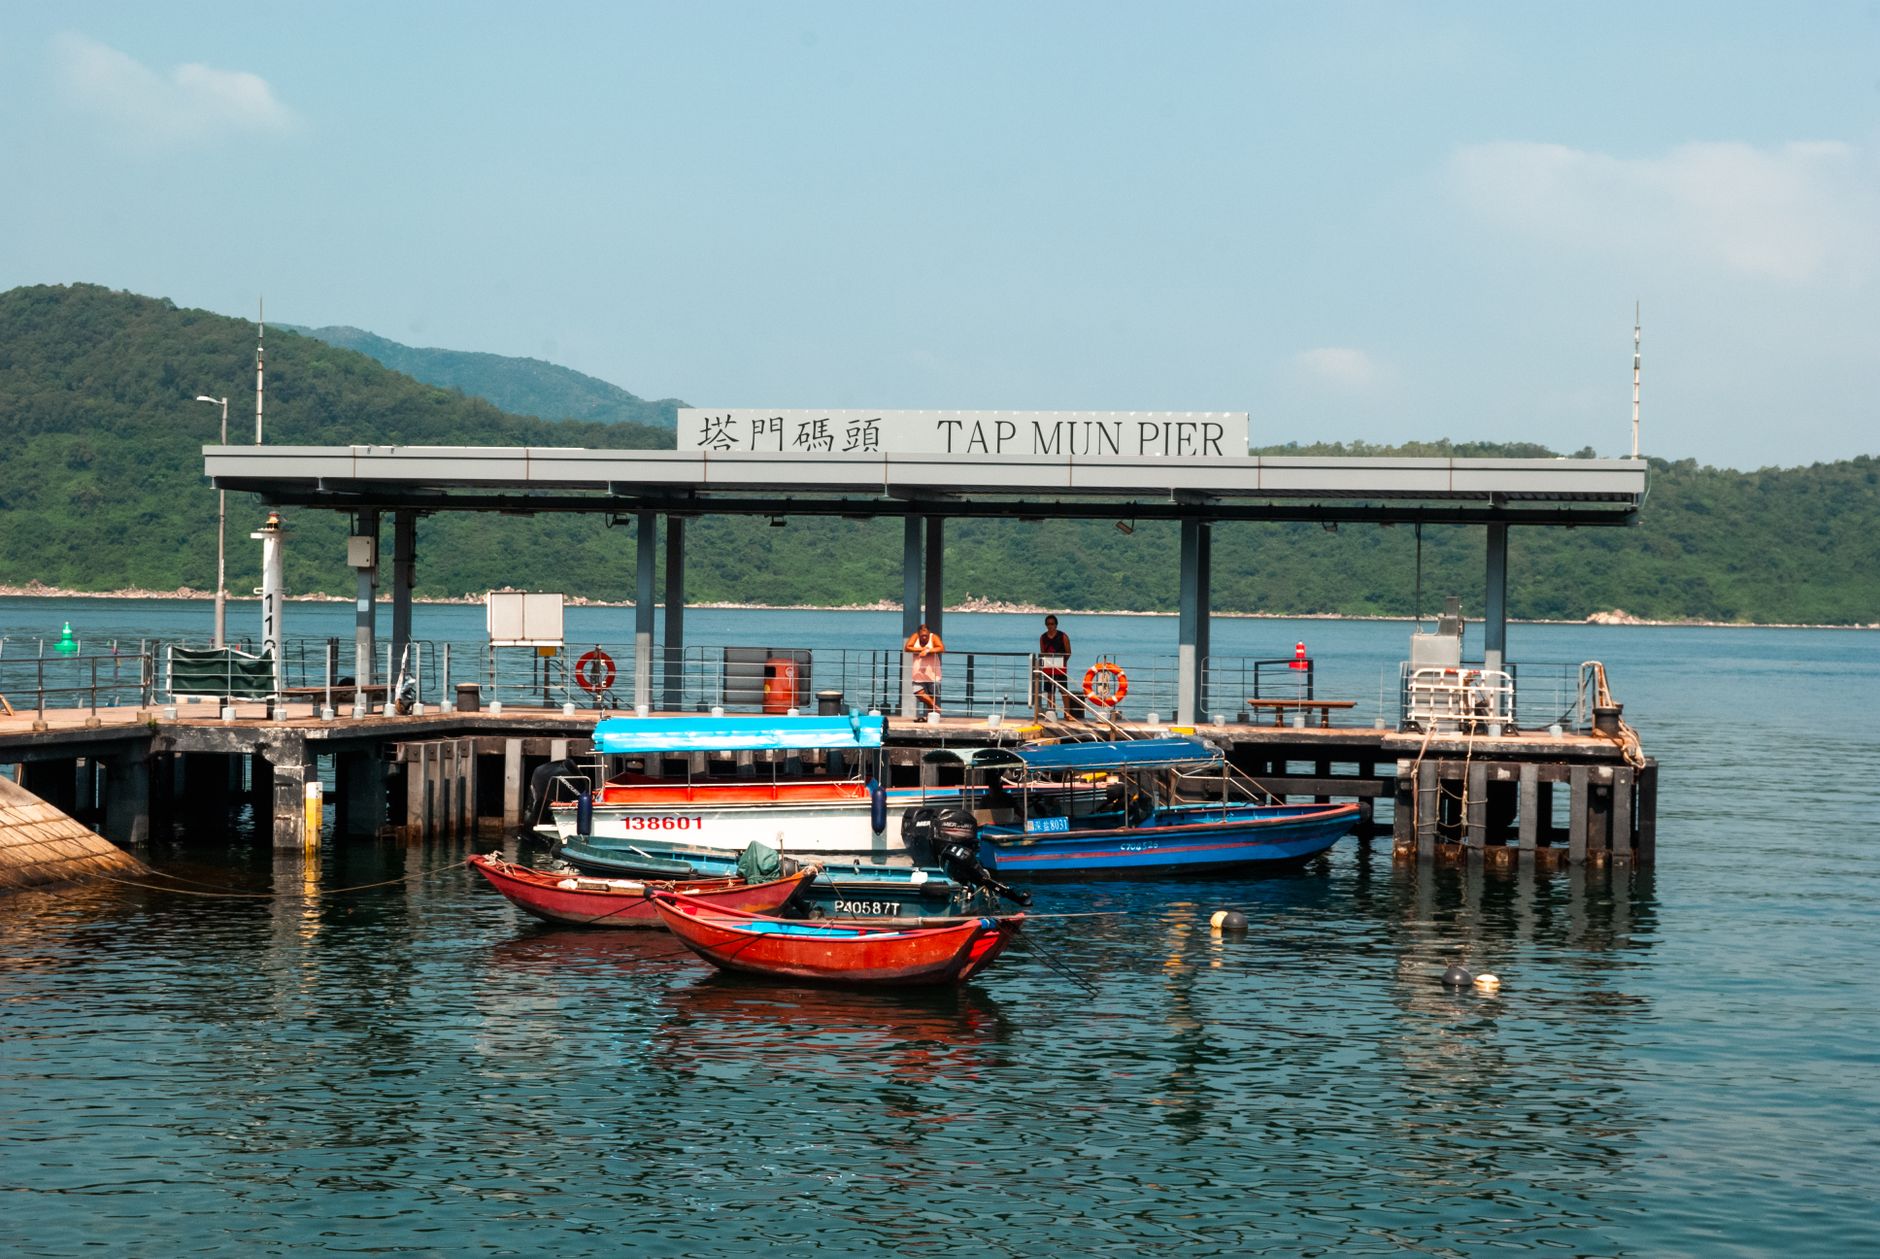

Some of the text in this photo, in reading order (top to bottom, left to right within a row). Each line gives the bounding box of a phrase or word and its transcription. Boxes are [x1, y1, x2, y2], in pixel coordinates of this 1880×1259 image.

[697, 414, 882, 452] 塔門碼頭
[936, 419, 1224, 457] TAP MUN PIER
[621, 816, 702, 830] 138601
[834, 900, 900, 915] P40587T
